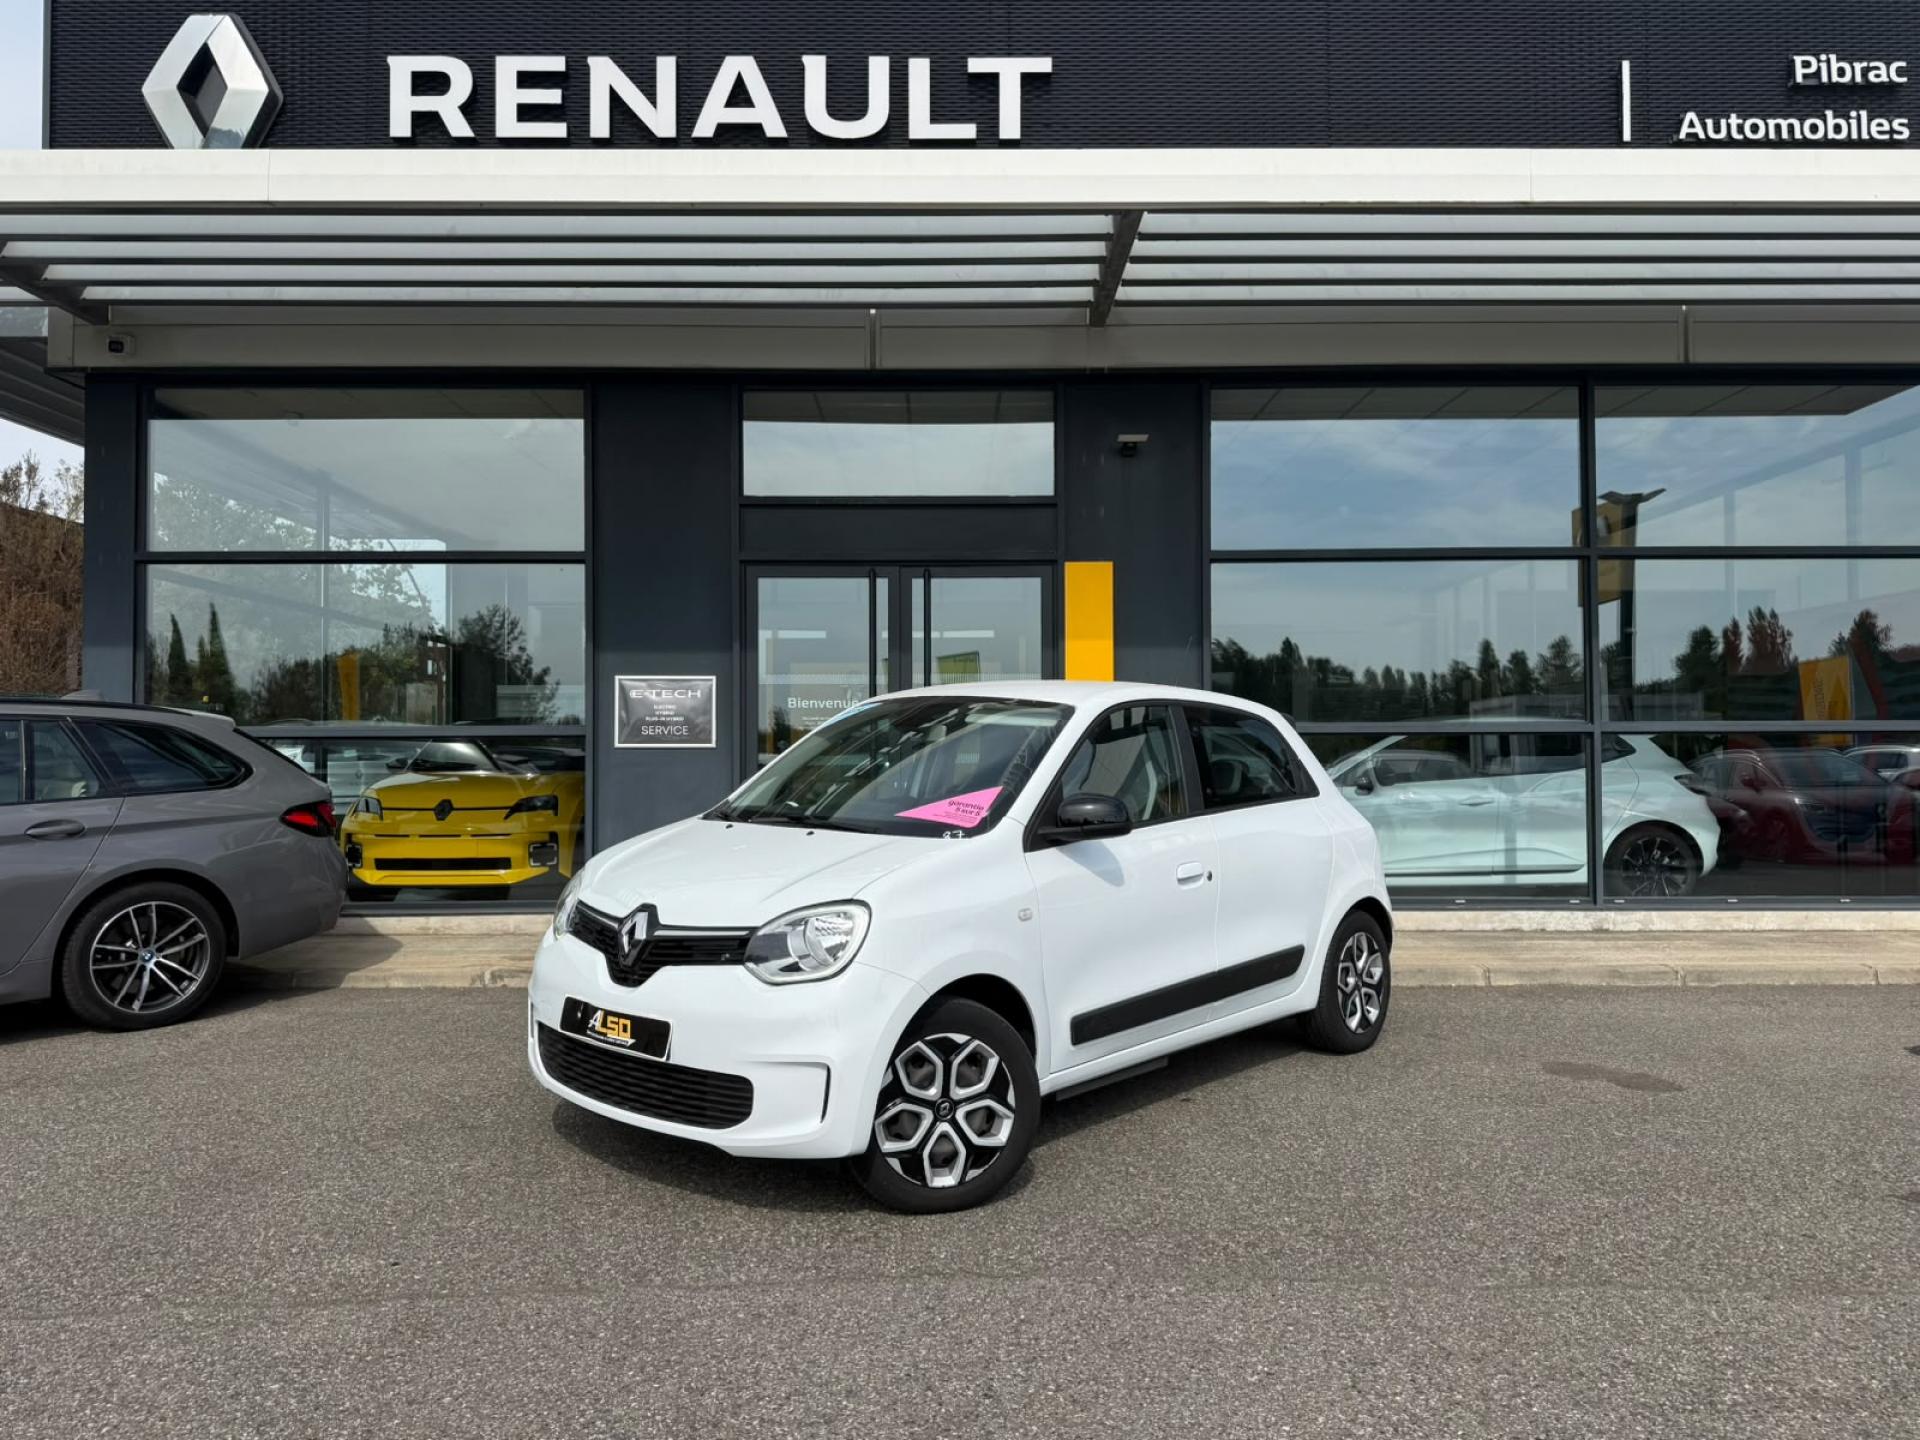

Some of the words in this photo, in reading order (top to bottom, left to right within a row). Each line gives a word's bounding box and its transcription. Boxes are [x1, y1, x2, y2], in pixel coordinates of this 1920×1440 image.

[1792, 53, 1908, 83] Pibrac
[387, 54, 1053, 140] RENAULT
[1678, 109, 1911, 141] Automobiles
[641, 725, 689, 735] SERVICE
